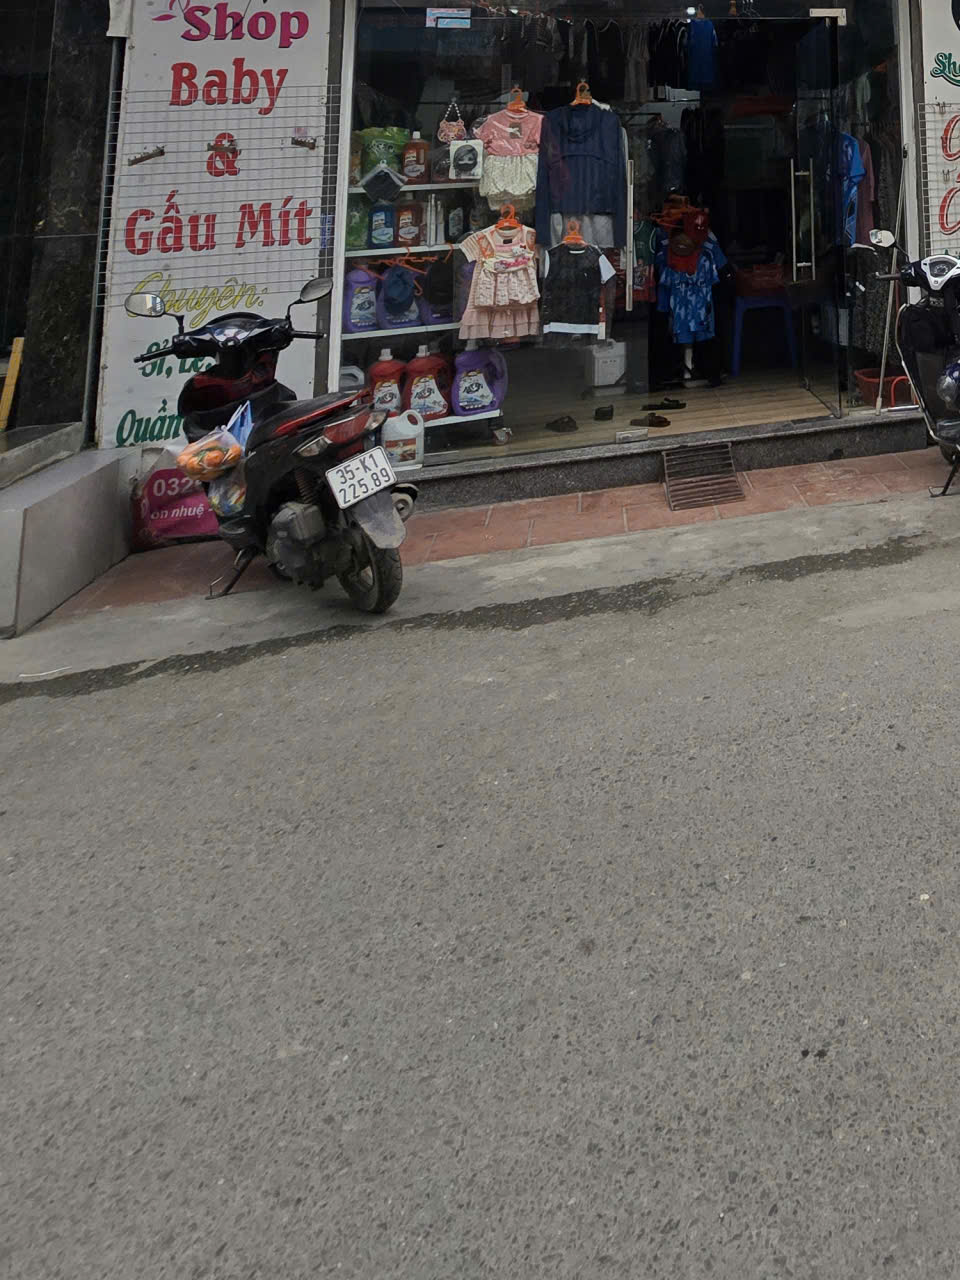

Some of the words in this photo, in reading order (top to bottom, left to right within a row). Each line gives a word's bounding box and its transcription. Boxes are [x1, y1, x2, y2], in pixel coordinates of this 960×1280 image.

[180, 2, 309, 48] Shop
[169, 57, 289, 116] Baby
[124, 189, 217, 256] Gấu
[235, 195, 313, 249] Mít
[336, 453, 379, 485] 35-K1
[339, 467, 391, 505] 225.89
